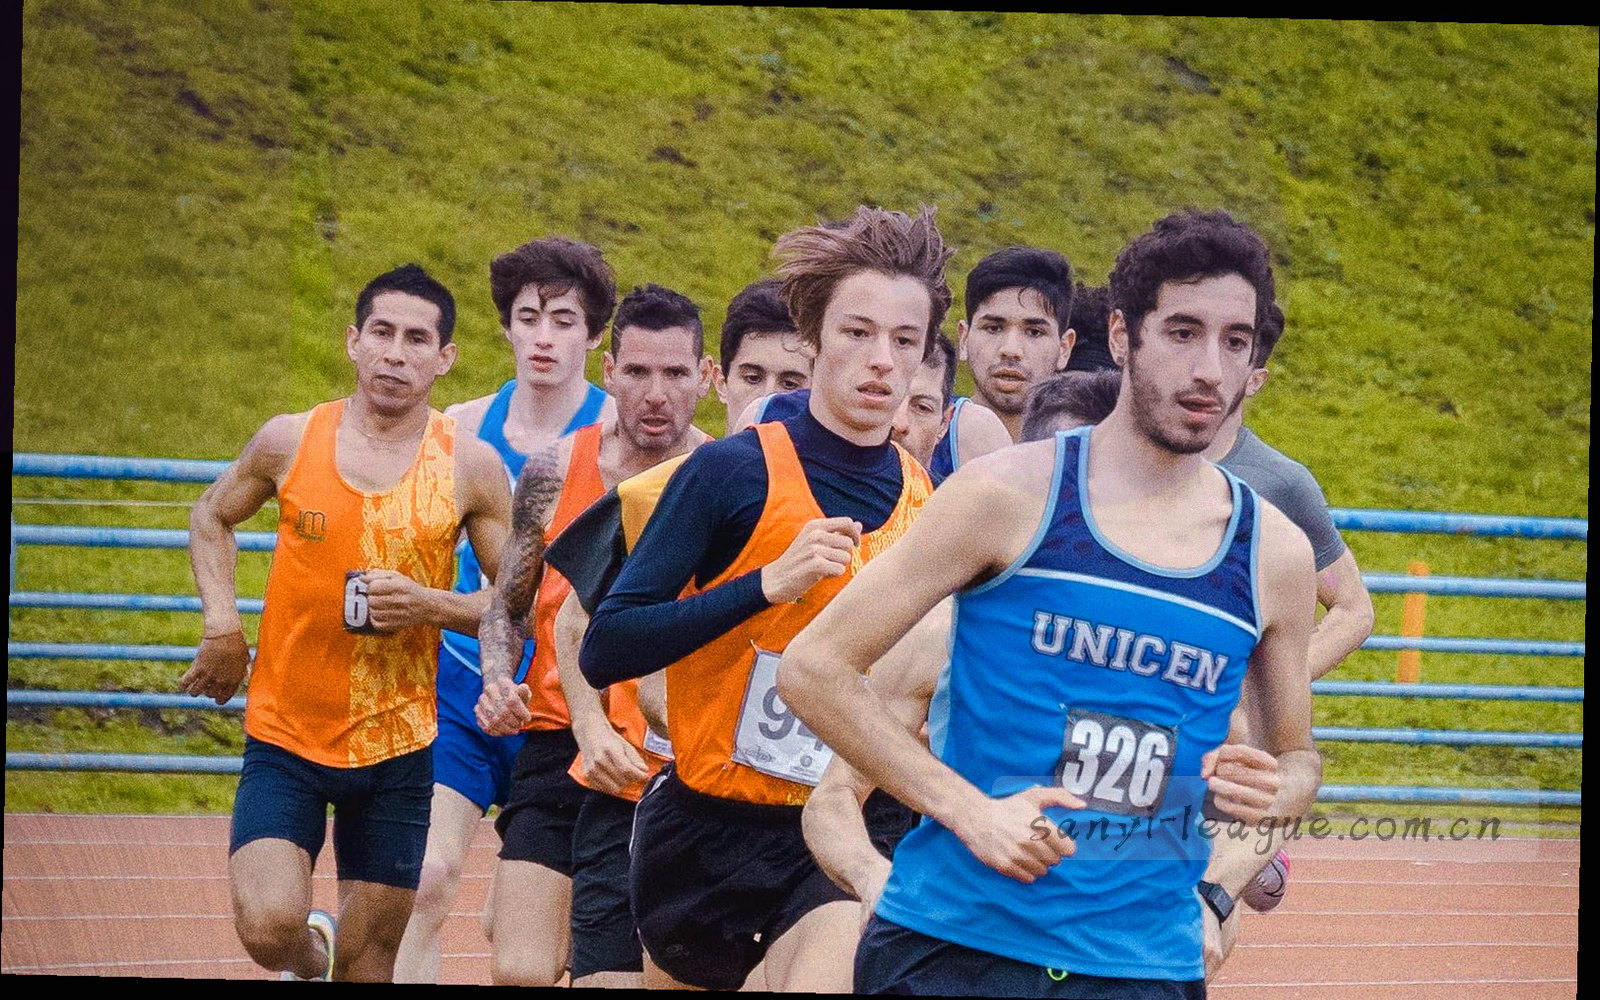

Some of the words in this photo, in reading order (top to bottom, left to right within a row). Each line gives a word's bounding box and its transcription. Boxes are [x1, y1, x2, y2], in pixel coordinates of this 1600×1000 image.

[345, 577, 368, 627] 6
[1031, 610, 1229, 694] UNICEN
[1061, 719, 1169, 807] 326
